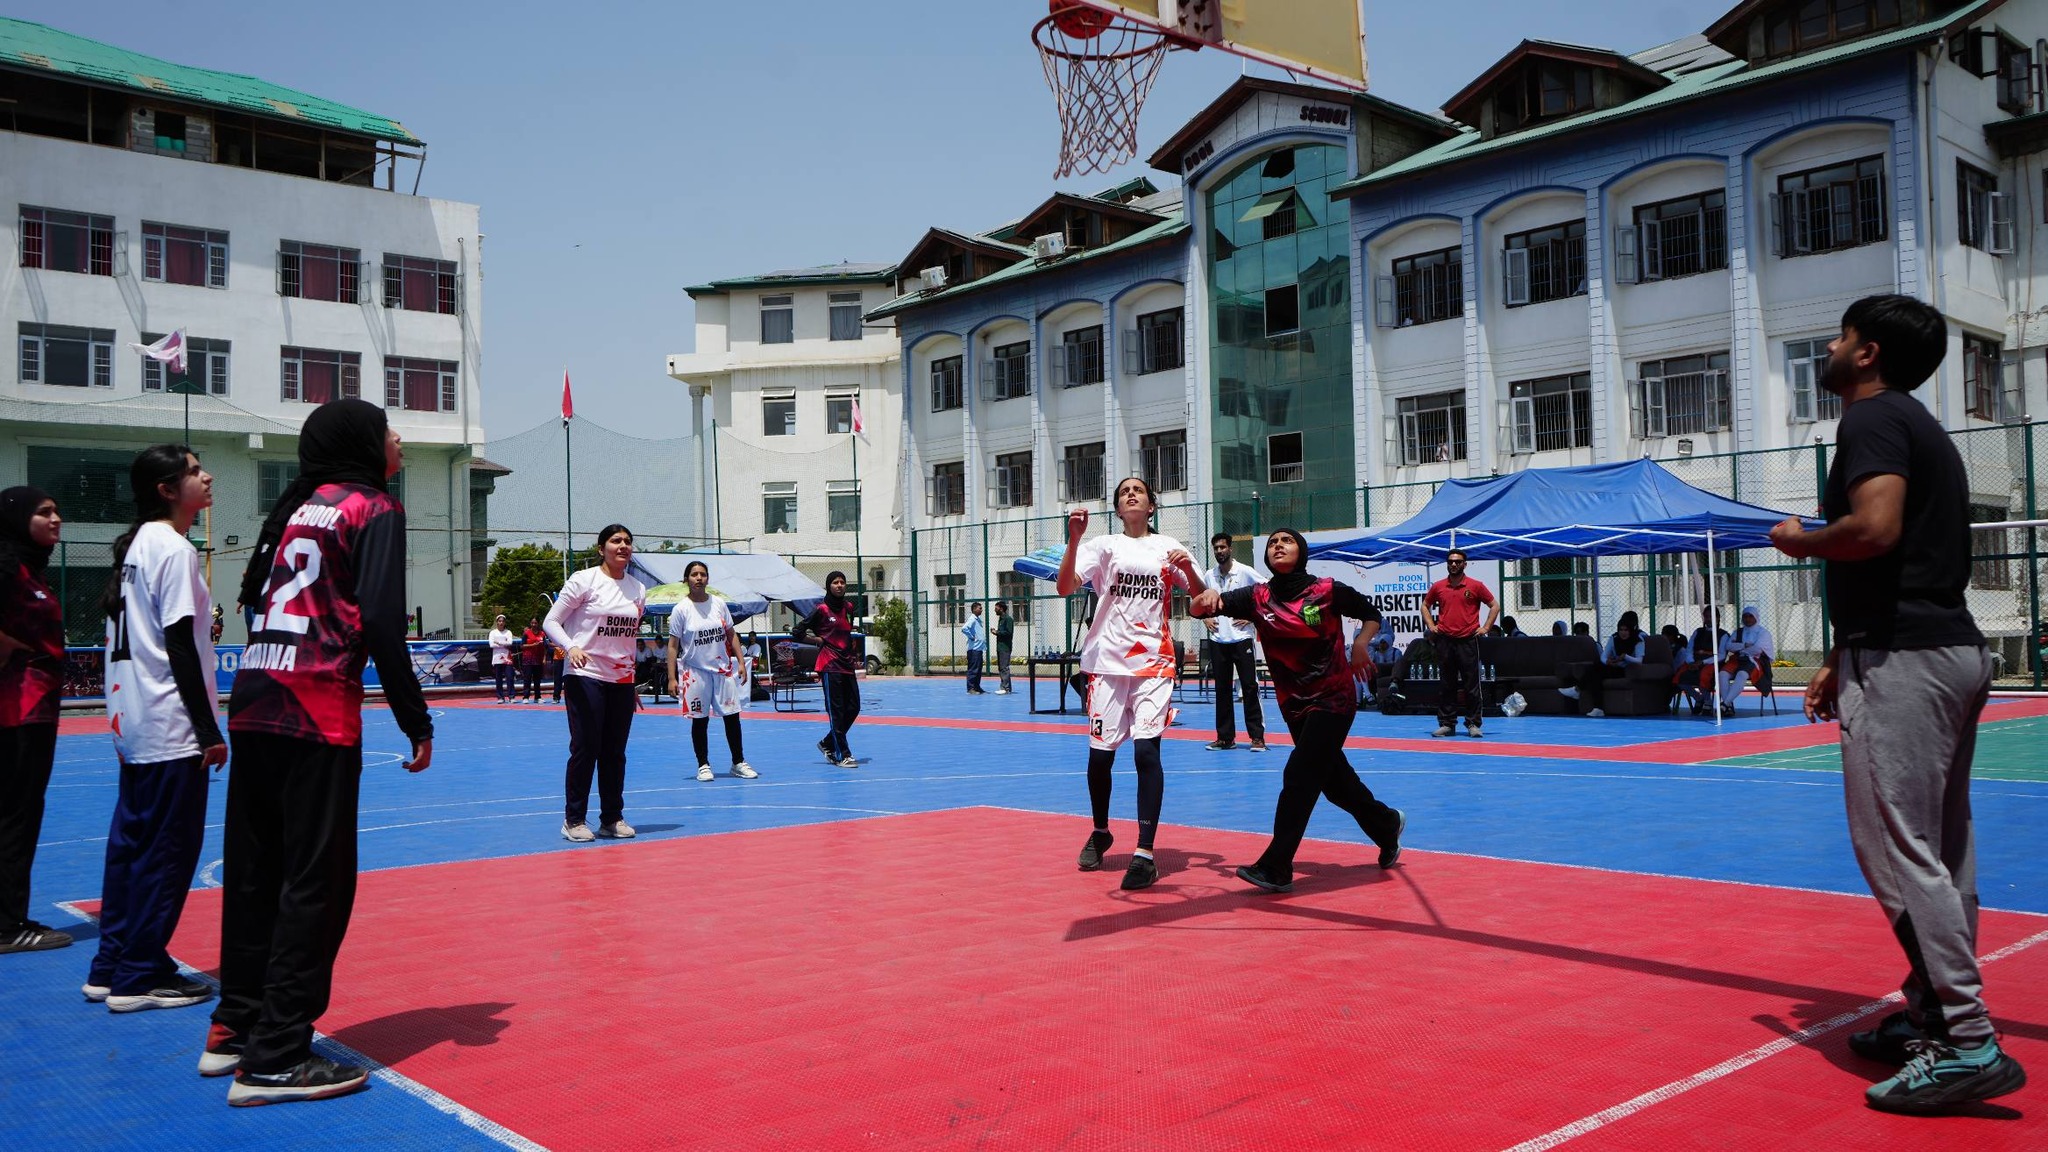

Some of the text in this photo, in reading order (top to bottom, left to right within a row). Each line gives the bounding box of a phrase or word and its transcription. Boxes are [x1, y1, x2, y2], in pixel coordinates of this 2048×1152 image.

[1184, 105, 1348, 171] DOON SCHOOL
[1117, 572, 1158, 587] BOMIS
[1375, 582, 1433, 592] INTER SCH
[607, 615, 638, 628] BOMIS
[698, 627, 723, 638] BOMIS
